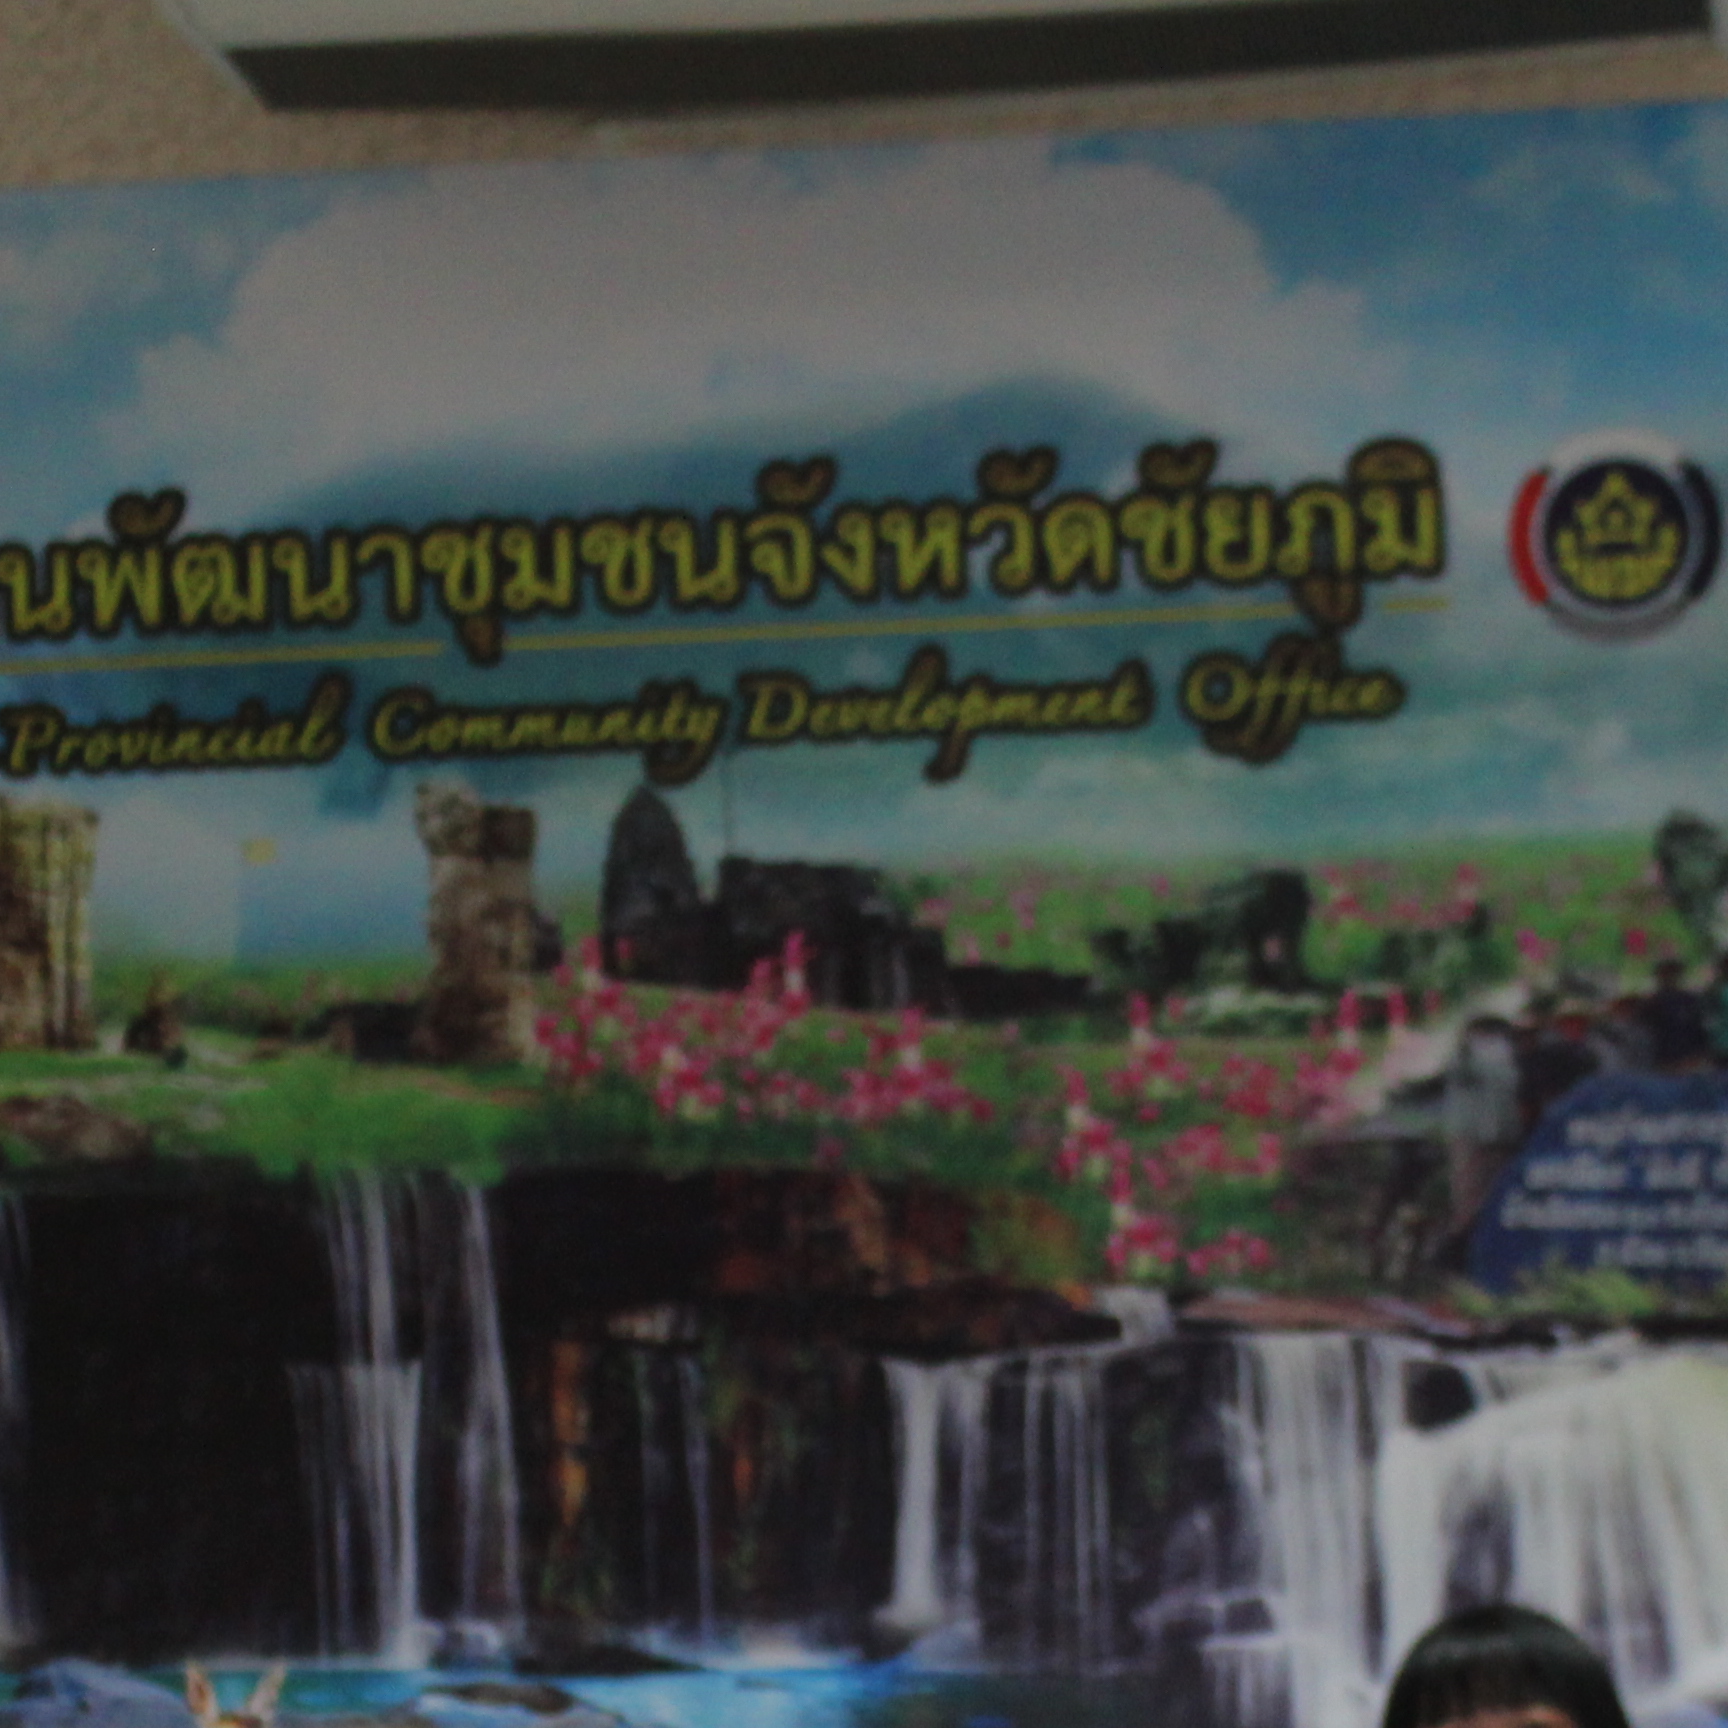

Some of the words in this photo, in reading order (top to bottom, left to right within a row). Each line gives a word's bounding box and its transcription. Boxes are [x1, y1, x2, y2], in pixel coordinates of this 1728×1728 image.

[368, 678, 726, 786] Community
[737, 645, 1152, 782] Development
[1178, 632, 1404, 765] Office
